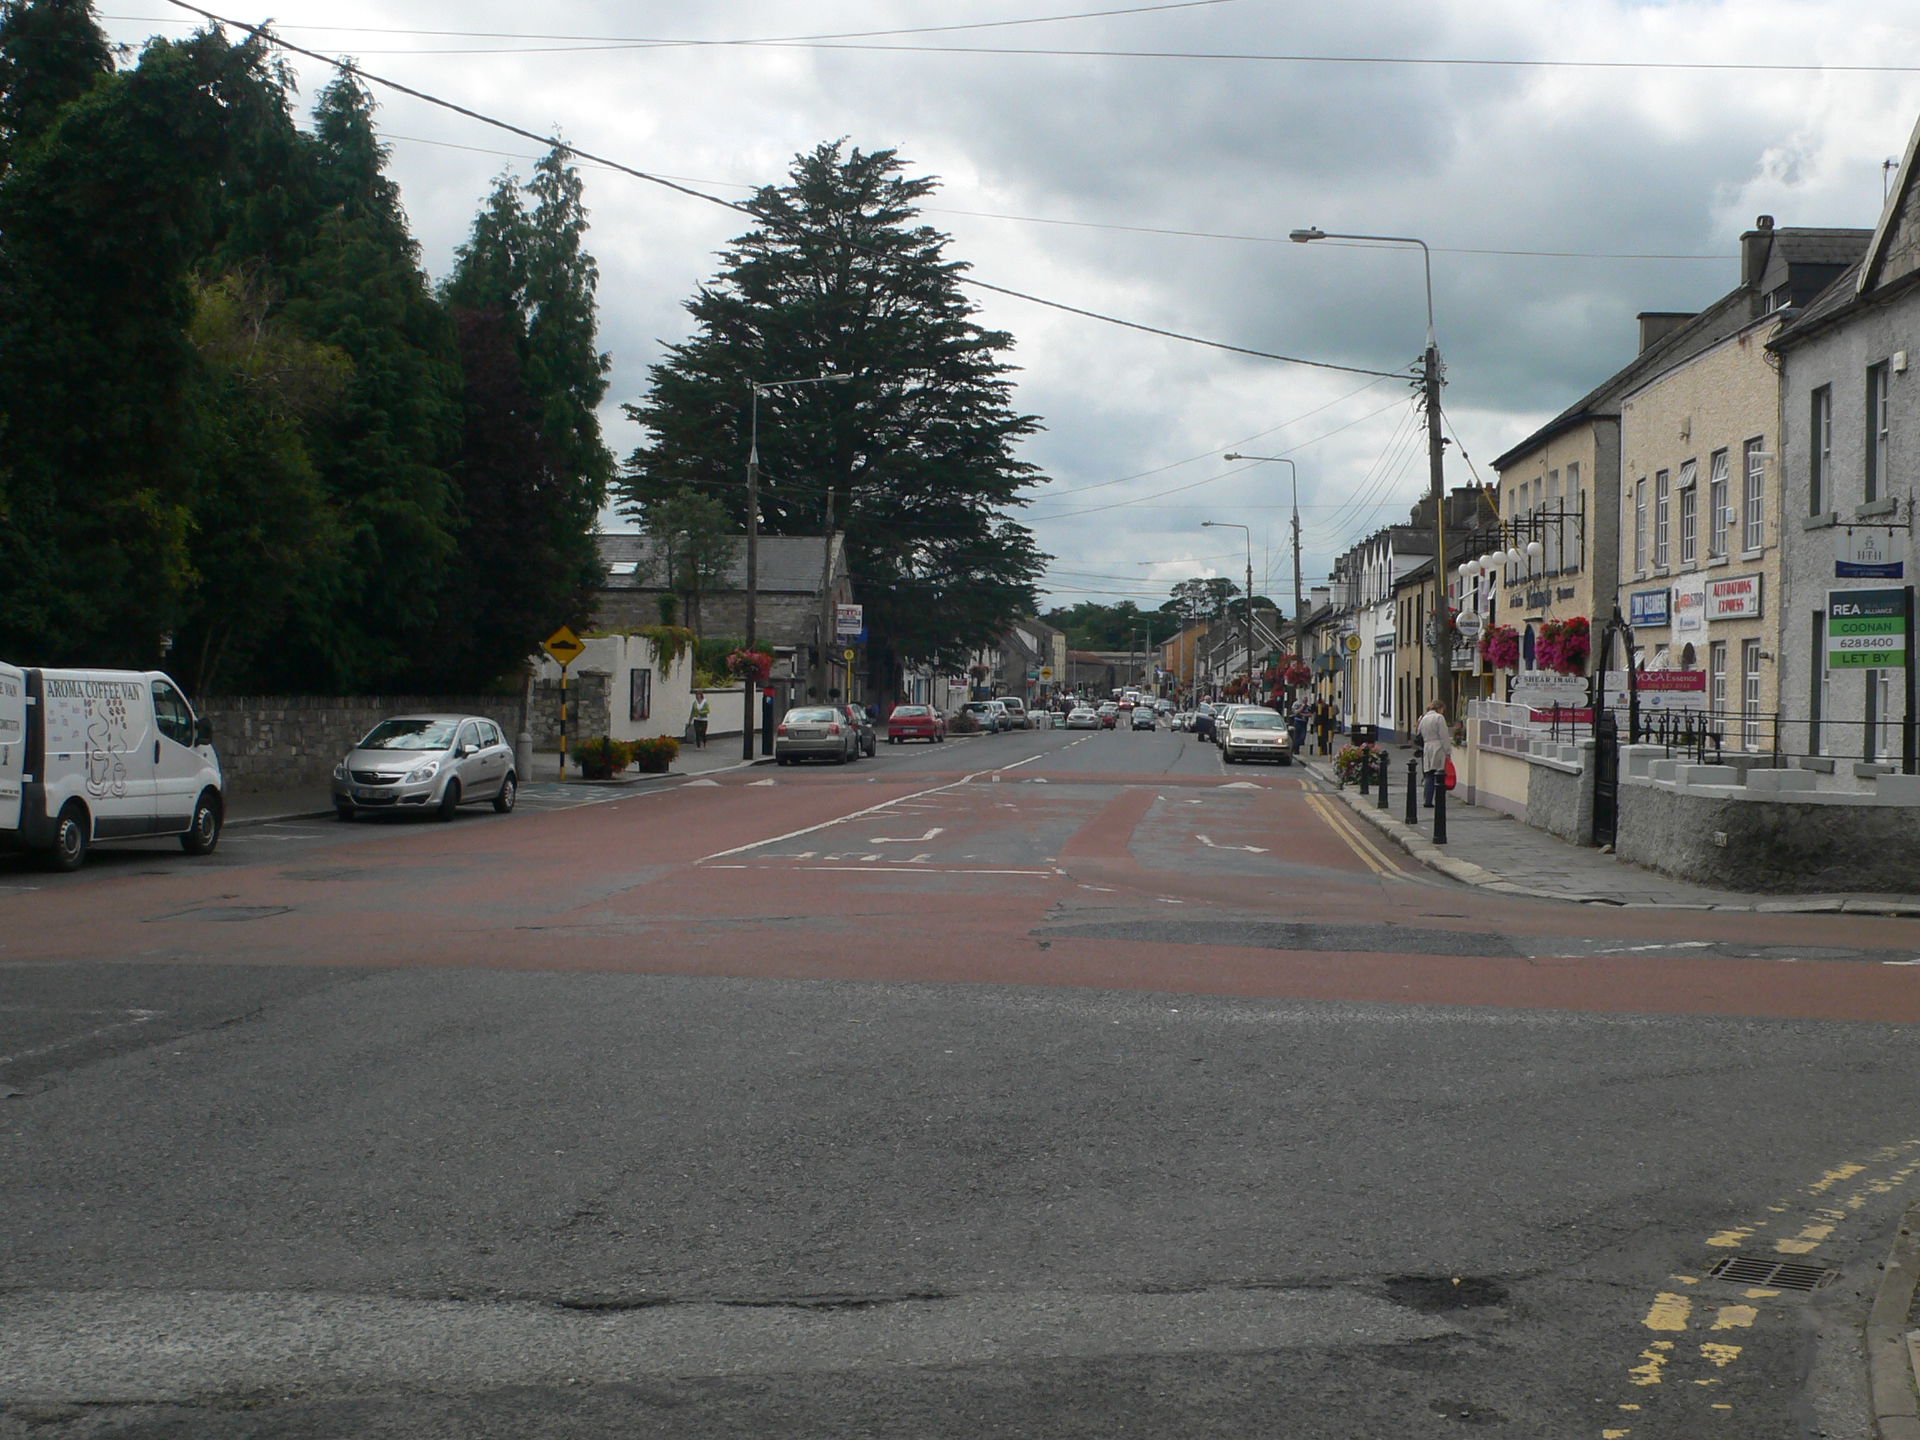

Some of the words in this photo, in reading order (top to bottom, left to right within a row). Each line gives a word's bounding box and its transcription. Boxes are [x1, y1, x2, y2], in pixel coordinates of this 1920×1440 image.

[1718, 598, 1745, 613] EXPRESS
[1833, 604, 1861, 616] REA
[1841, 623, 1892, 633] COONAN
[1840, 638, 1893, 649] 6288400
[1842, 654, 1868, 664] LET
[1873, 653, 1890, 663] BY
[1523, 676, 1551, 684] SHEAR
[1635, 672, 1665, 682] YOGA
[1666, 673, 1697, 682] Essence
[6, 685, 17, 697] VAN
[48, 680, 83, 698] AROMA
[86, 681, 121, 700] COFFEE
[122, 683, 140, 701] VAN
